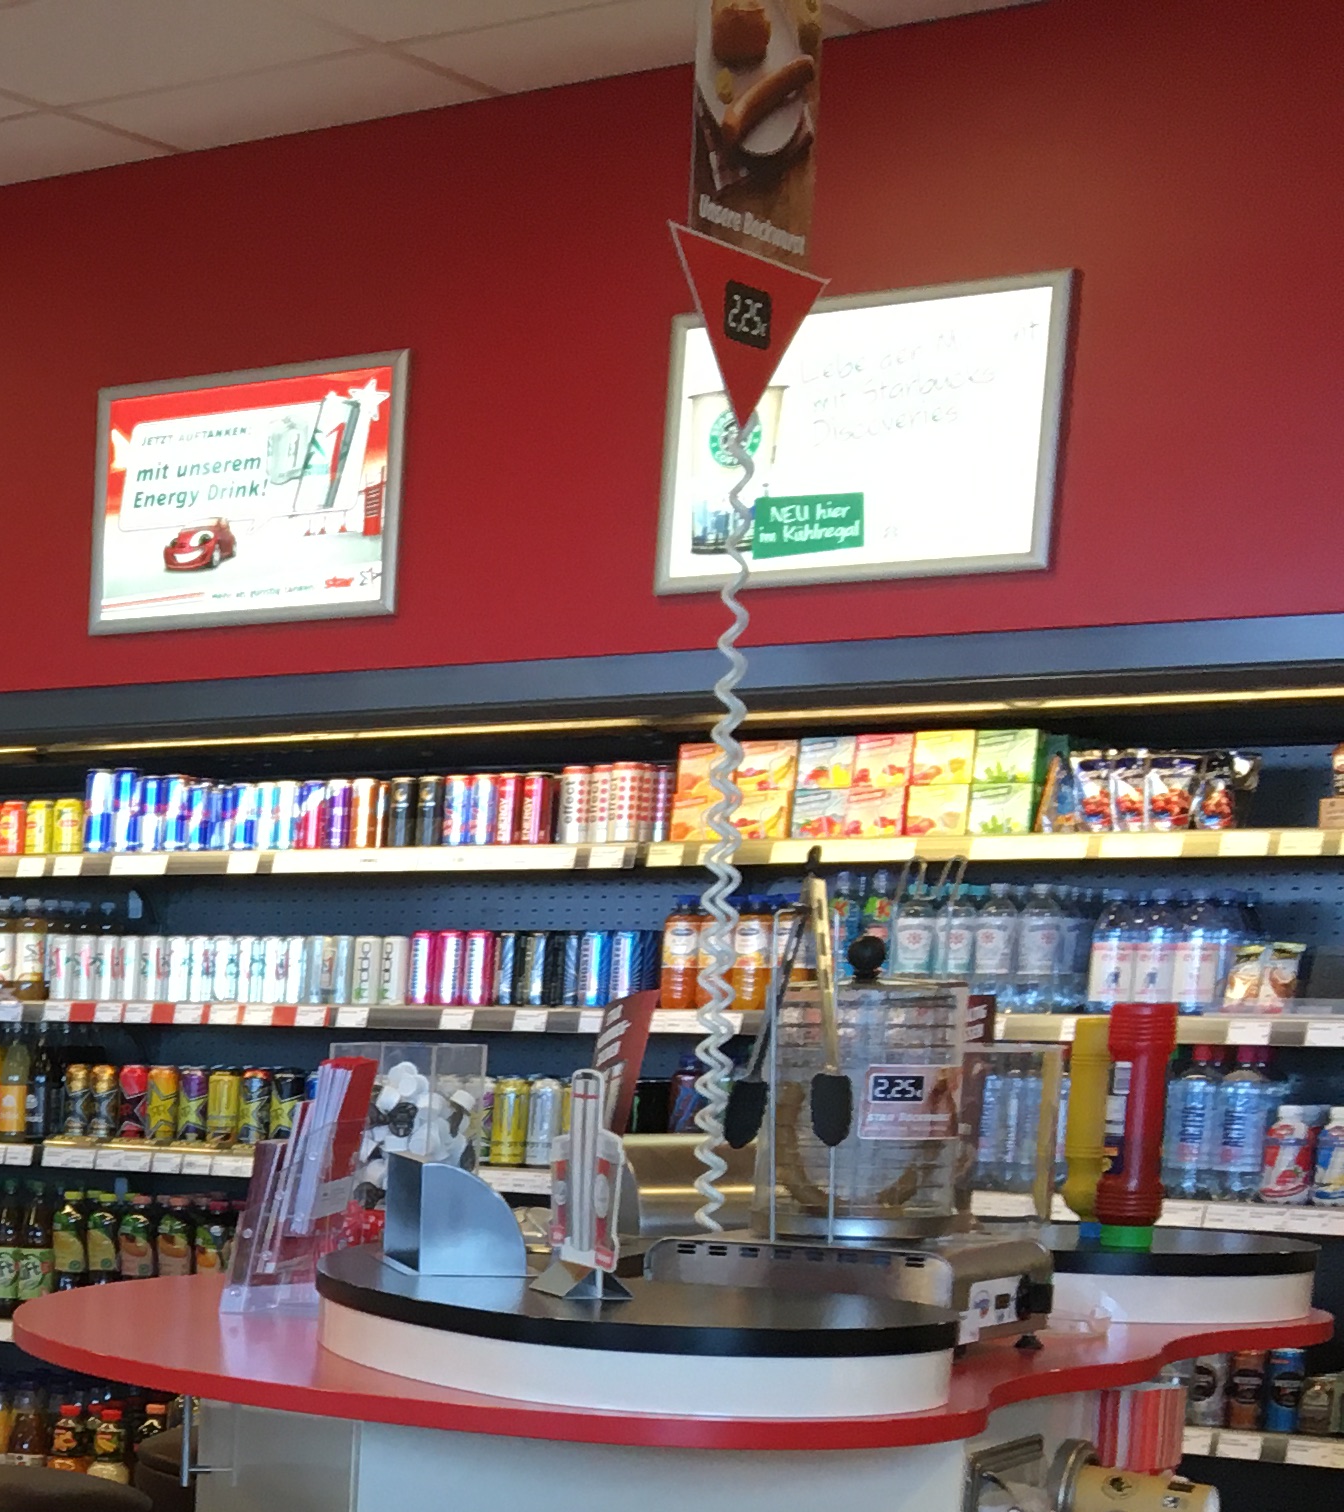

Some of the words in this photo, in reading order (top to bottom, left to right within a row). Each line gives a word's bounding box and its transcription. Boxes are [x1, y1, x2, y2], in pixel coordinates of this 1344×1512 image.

[135, 461, 170, 482] mit
[175, 455, 263, 479] unserem
[132, 488, 200, 510] Energy
[206, 478, 269, 502] Drink!
[769, 504, 810, 524] NEU
[814, 501, 852, 521] hier
[782, 518, 862, 544] Kühlregal
